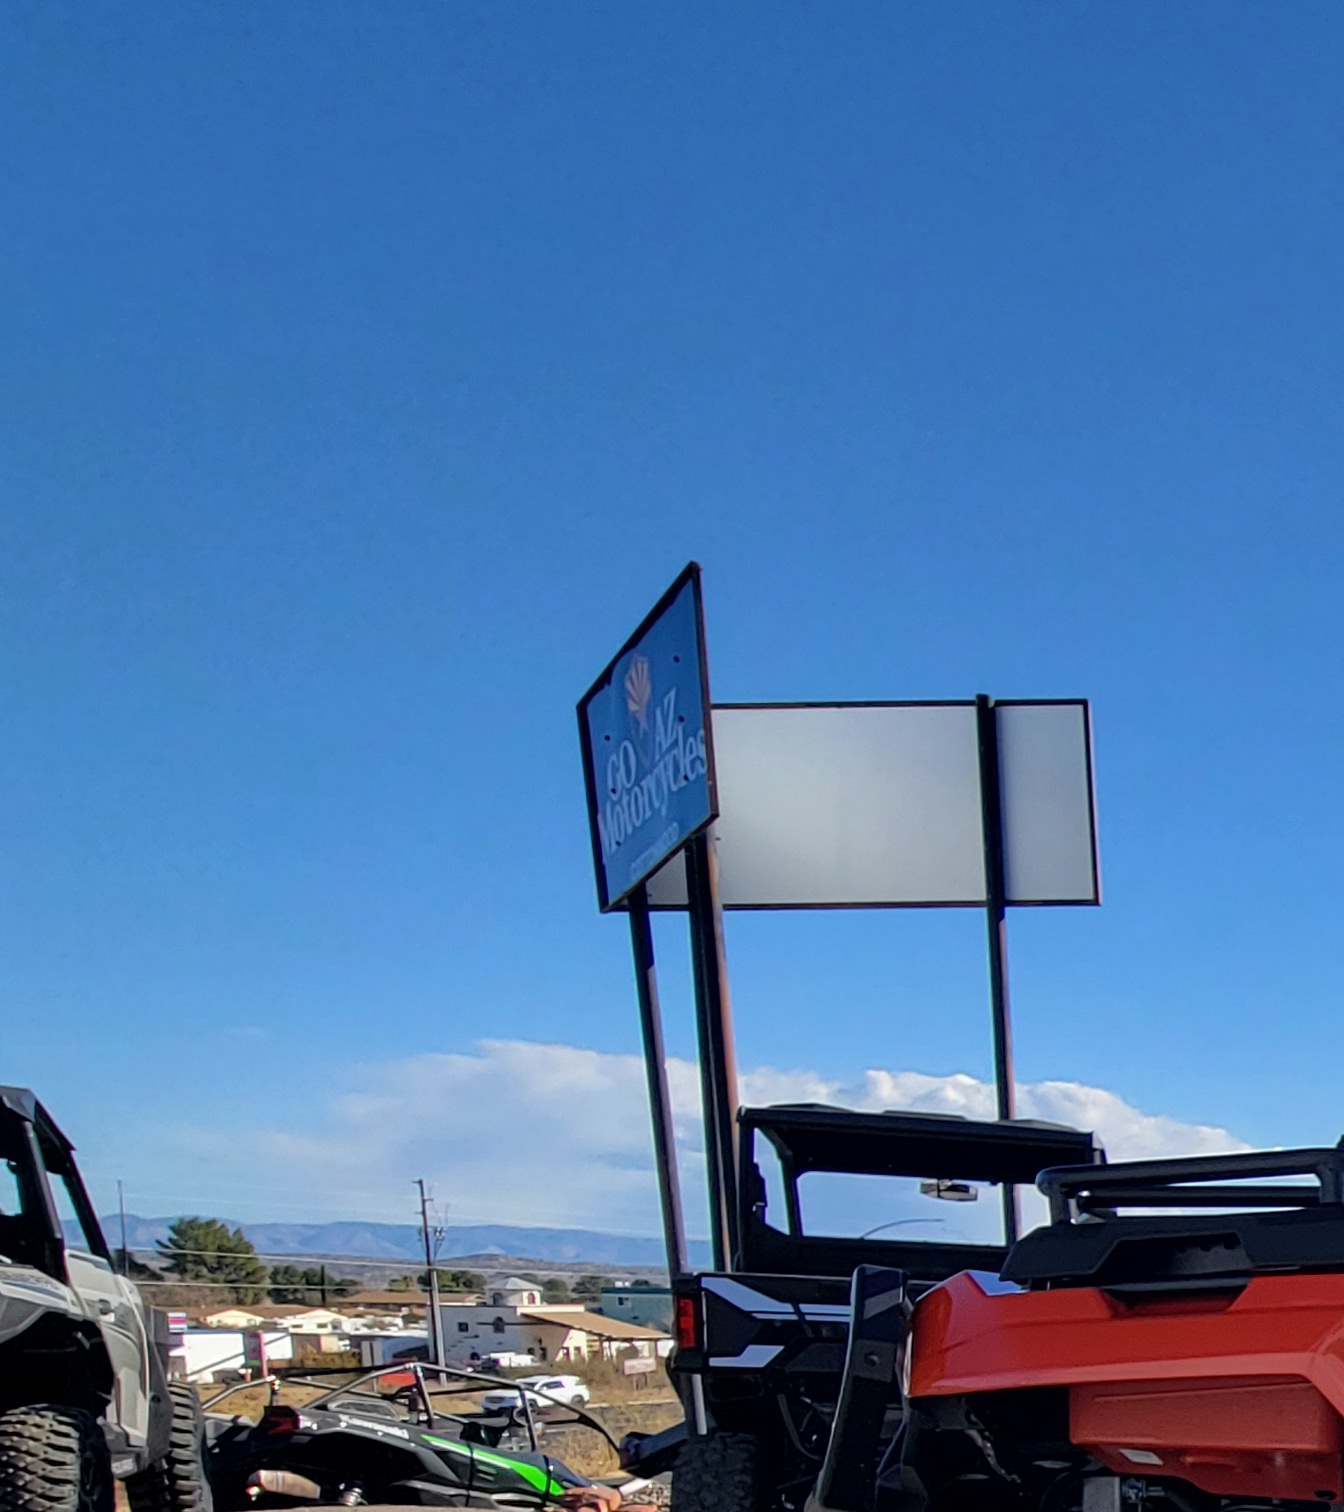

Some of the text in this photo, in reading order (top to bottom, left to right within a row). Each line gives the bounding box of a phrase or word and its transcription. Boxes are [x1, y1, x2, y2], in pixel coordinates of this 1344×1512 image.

[598, 723, 706, 854] Motorcycles
[606, 687, 679, 801] GO AZ
